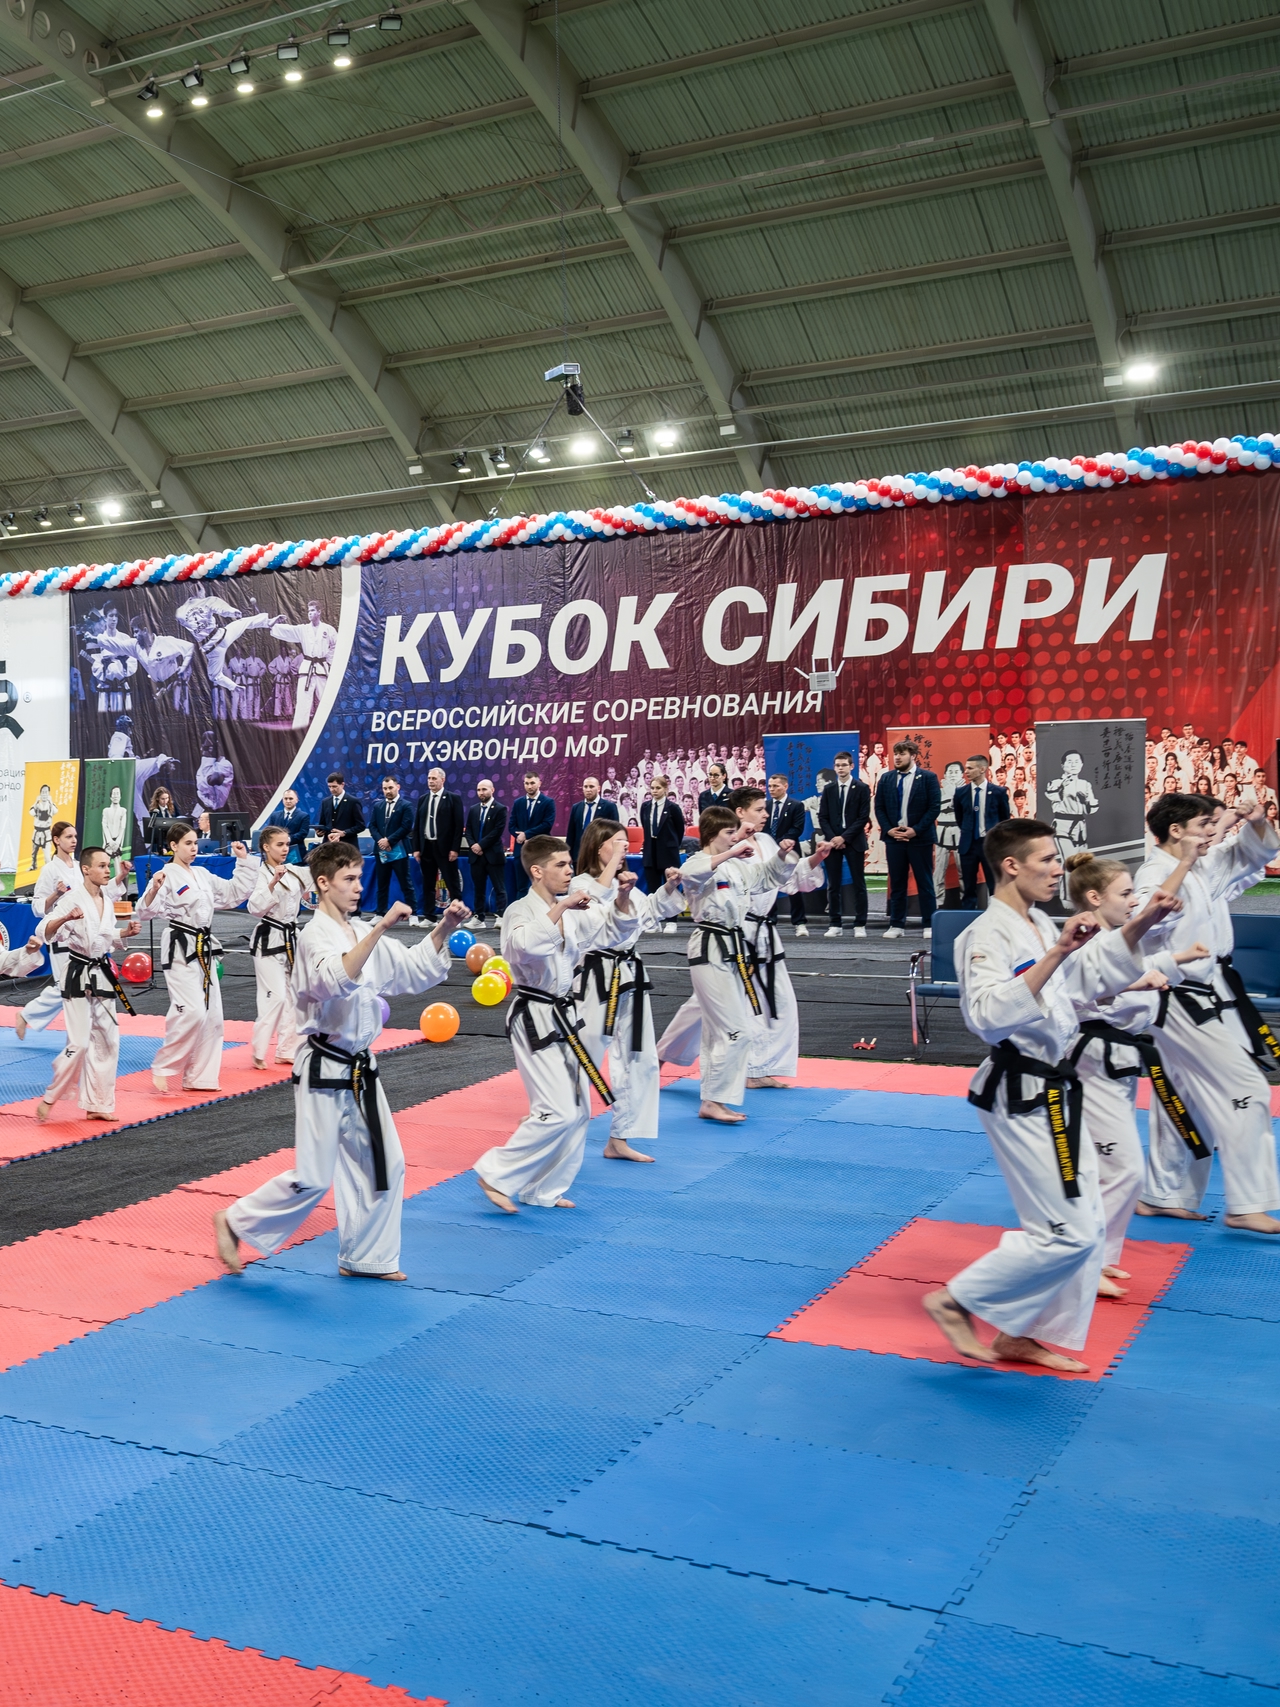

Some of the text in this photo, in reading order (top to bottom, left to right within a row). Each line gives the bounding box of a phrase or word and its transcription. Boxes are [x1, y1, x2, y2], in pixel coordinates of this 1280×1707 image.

[378, 552, 1169, 686] КУБОК СИБИРИ
[371, 690, 823, 732] ВСЕРОССИЙСКИЕ СОРЕВНОВАНИЯ
[366, 733, 628, 764] ПО ТХЭКВОНДО МФТ
[1047, 1089, 1060, 1103] ALL
